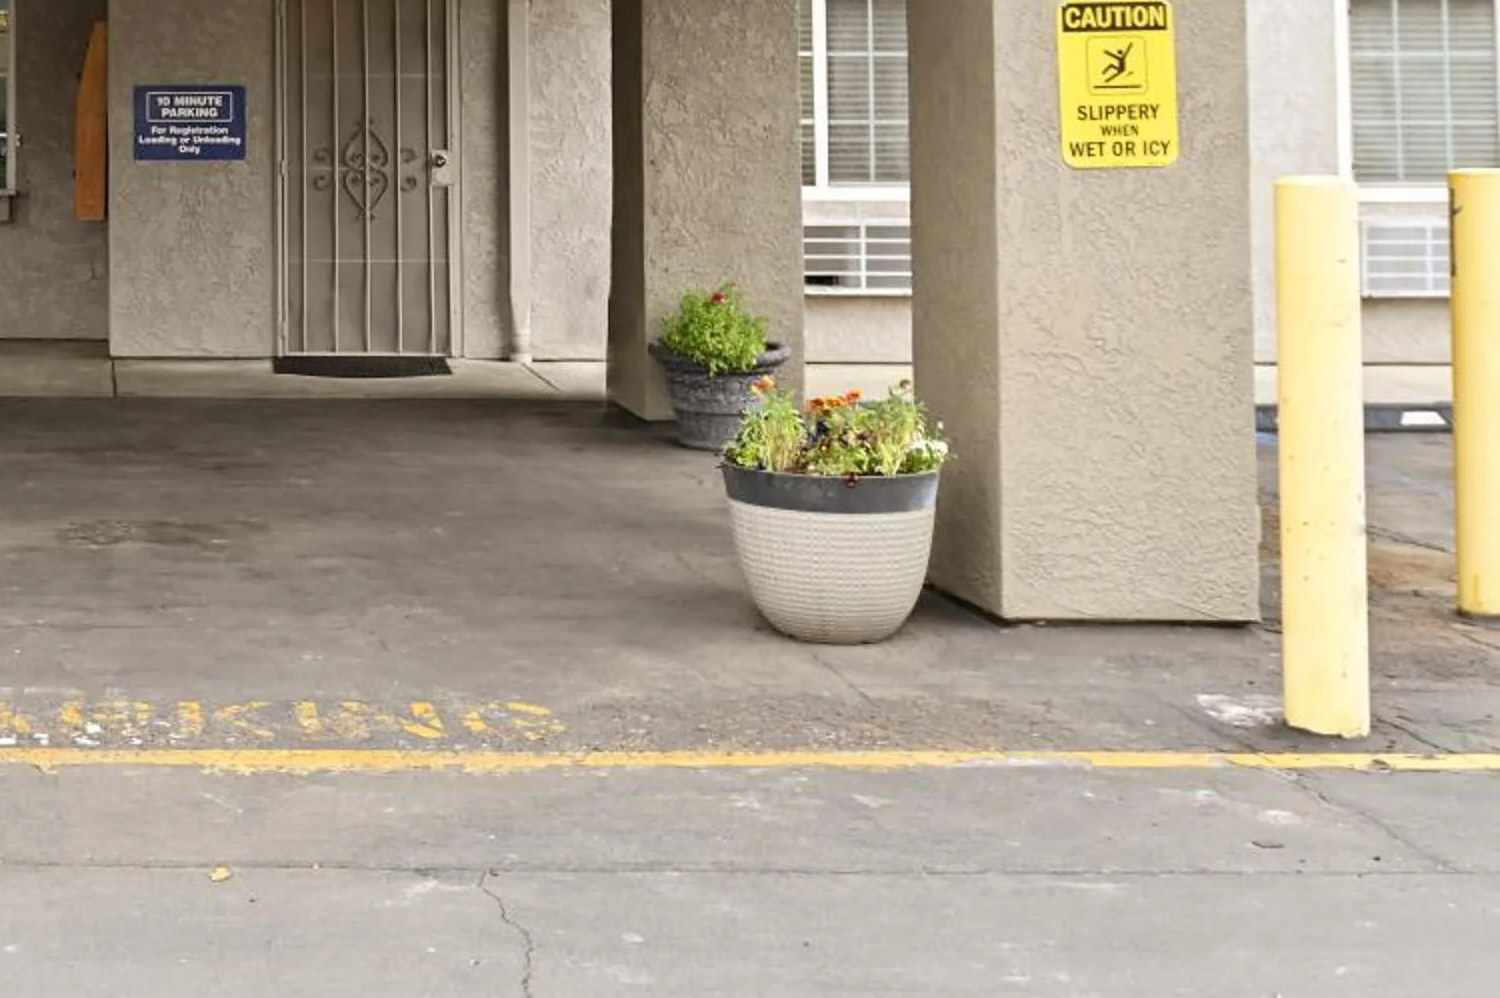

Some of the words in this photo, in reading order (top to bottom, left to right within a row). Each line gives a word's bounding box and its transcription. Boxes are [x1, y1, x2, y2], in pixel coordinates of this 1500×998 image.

[1065, 5, 1165, 28] CAUTION
[156, 96, 171, 106] 10
[173, 95, 223, 106] MINUTE
[161, 107, 218, 118] PARKING
[1077, 104, 1160, 121] SLIPPERY
[151, 125, 166, 135] For
[169, 125, 229, 136] Registration
[1100, 124, 1139, 136] WHEN
[138, 135, 177, 146] Loading
[192, 135, 241, 146] Unloading
[178, 145, 200, 155] Only
[1069, 141, 1106, 157] WET
[1111, 140, 1136, 156] OR
[1143, 139, 1171, 156] ICY
